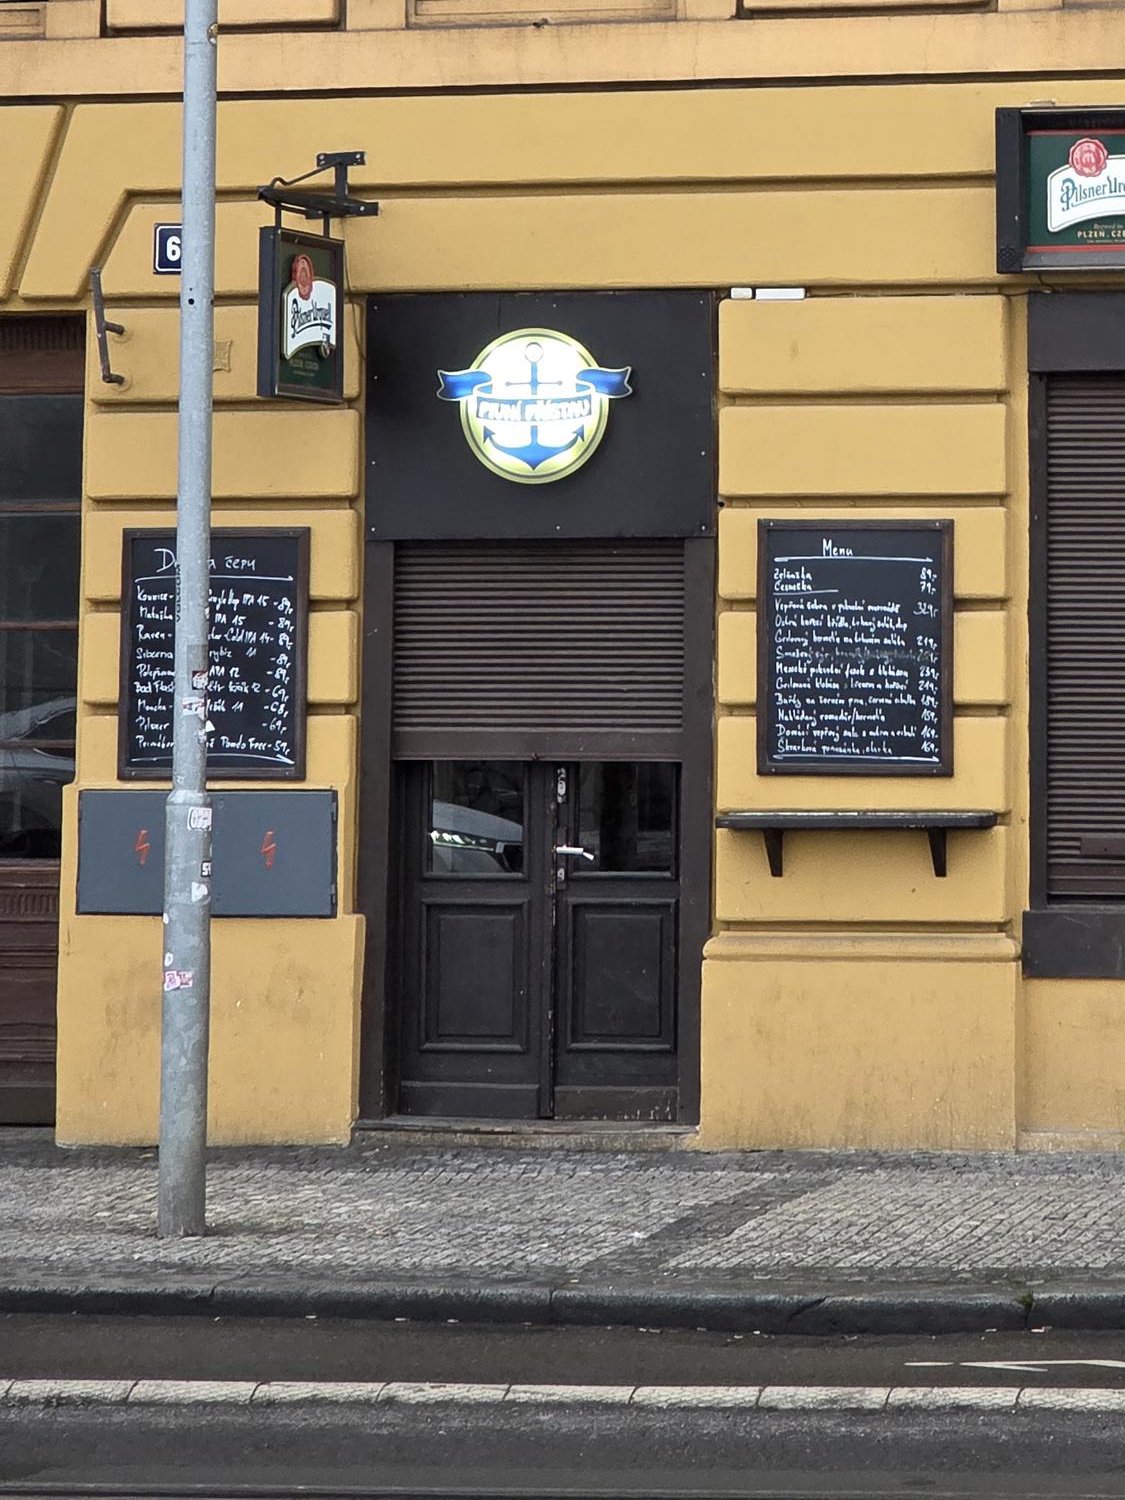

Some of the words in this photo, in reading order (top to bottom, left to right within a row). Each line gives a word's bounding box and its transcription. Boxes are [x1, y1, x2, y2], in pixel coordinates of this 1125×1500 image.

[1060, 177, 1107, 212] Pilsner
[166, 235, 181, 262] 6
[822, 538, 854, 557] Menu
